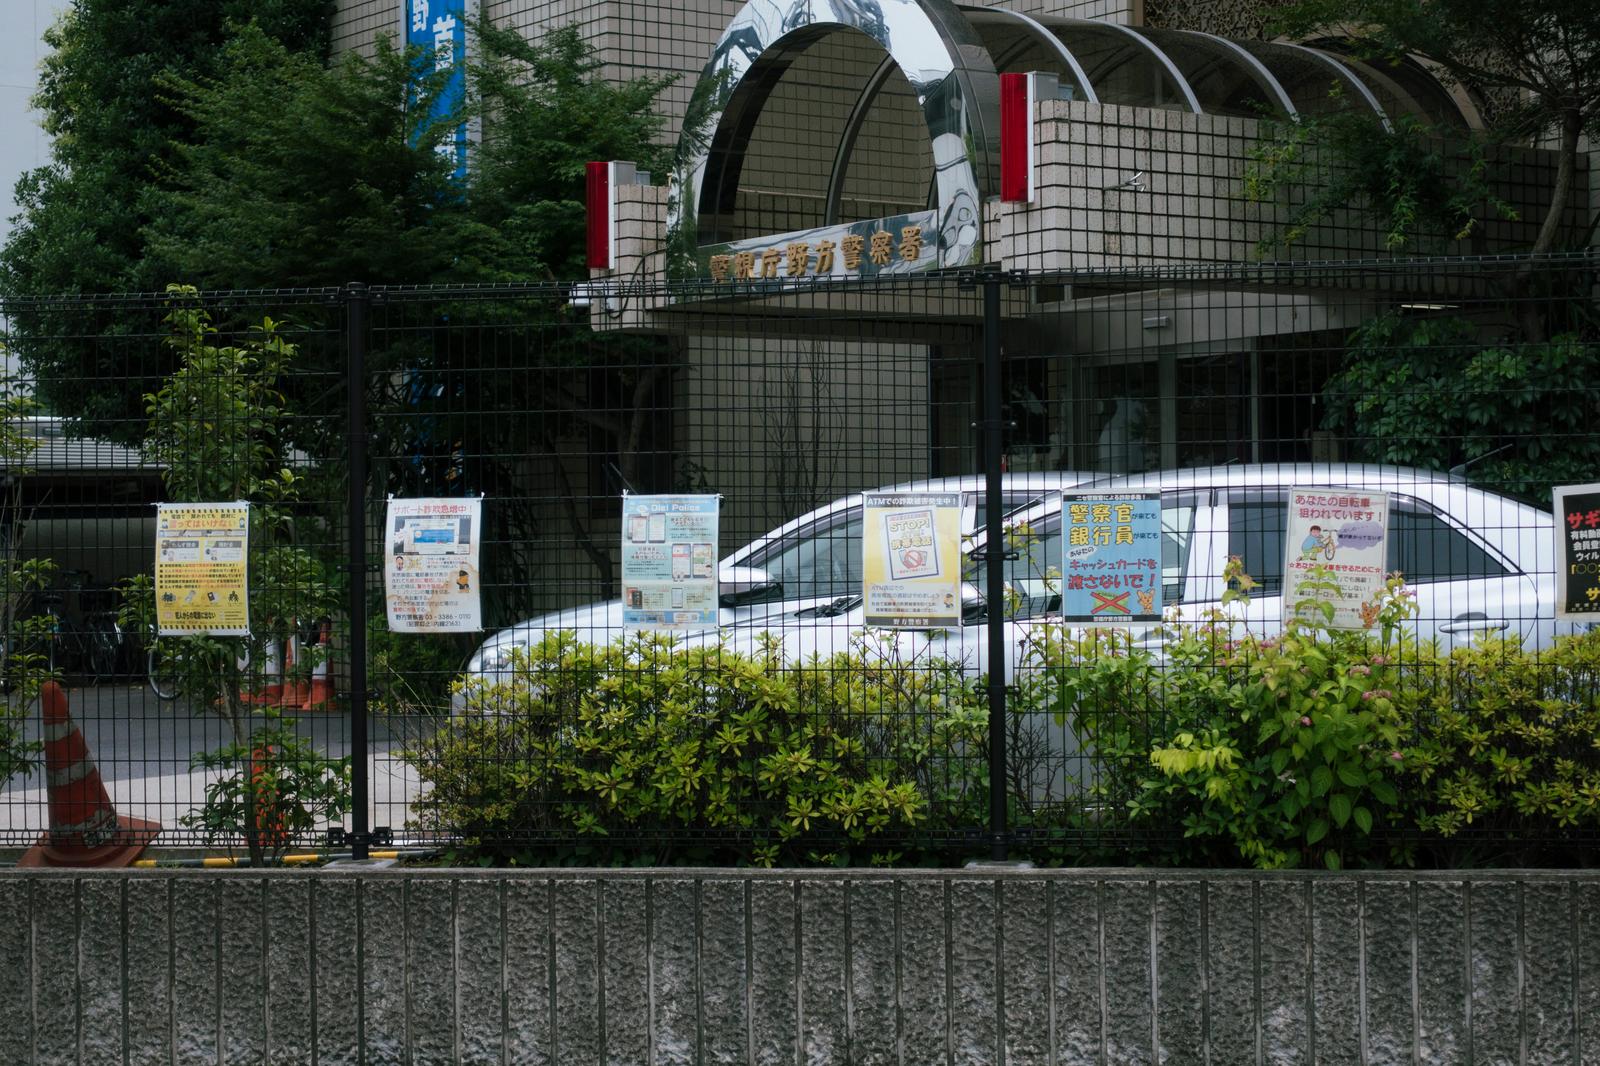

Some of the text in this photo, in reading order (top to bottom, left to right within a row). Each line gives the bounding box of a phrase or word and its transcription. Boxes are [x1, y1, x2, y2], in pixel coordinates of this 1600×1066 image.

[710, 226, 923, 283] 警視庁野方警察署
[1296, 495, 1370, 508] あなたの自転車
[394, 504, 472, 514] サポート詐欺急増中！
[1300, 508, 1382, 522] 狙われています！
[170, 520, 236, 528] ってはいけない
[1573, 540, 1600, 550] 会員登
[1070, 546, 1094, 558] あなたの
[1070, 559, 1157, 570] キャッシュカードを
[1068, 574, 1156, 590] 渡さないで！
